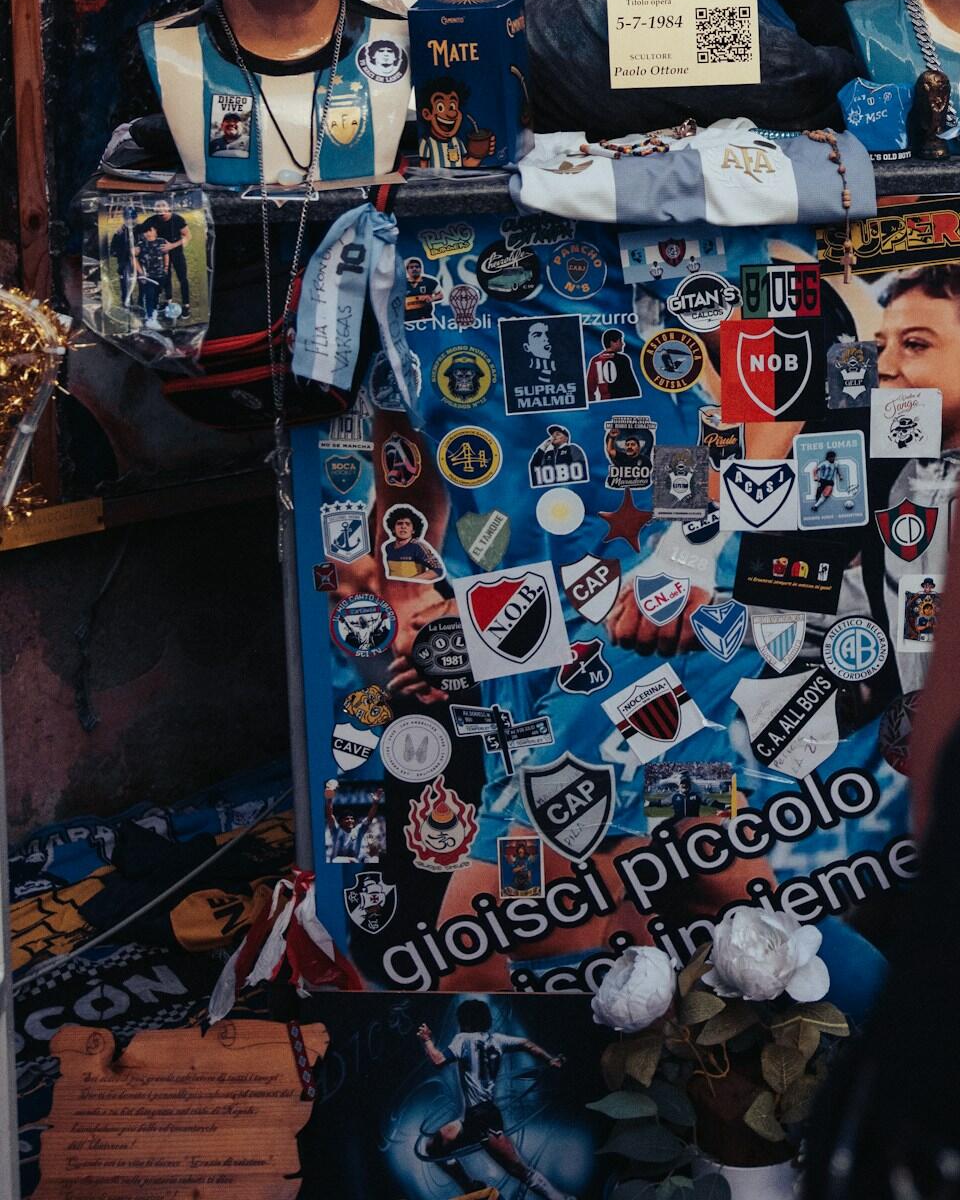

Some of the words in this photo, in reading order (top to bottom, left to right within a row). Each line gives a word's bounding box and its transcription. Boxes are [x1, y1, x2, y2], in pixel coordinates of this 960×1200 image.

[615, 15, 683, 31] 5-7-1984
[427, 40, 479, 68] MATE
[614, 66, 647, 77] Paolo
[650, 65, 689, 75] Ottone
[218, 95, 247, 104] DIEGO
[865, 110, 888, 124] MSC
[870, 153, 882, 161] L'S
[883, 153, 897, 161] OLD
[897, 151, 912, 160] BOYS
[336, 243, 367, 276] 10
[553, 244, 602, 269] PANCHO
[582, 312, 639, 327] zzurro
[692, 309, 724, 320] CALCOS
[331, 305, 352, 373] VARGAS
[646, 331, 675, 355] ASTON
[681, 331, 702, 360] VILLA
[750, 354, 799, 372] NOB
[595, 360, 618, 385] 10
[514, 383, 577, 397] SUPRAS
[653, 375, 688, 390] FUTSAL
[517, 394, 575, 409] MALMÖ
[800, 443, 823, 451] TRES
[826, 439, 857, 449] LOMAS
[611, 466, 650, 478] DIEGO
[572, 565, 609, 601] CAP
[348, 593, 375, 601] CANTO
[829, 619, 863, 640] ATLETICO
[866, 622, 888, 663] BELGRANO
[441, 655, 463, 667] 1981
[825, 643, 834, 665] CLUB
[837, 666, 878, 680] CORDOBA
[441, 677, 469, 691] SIDE
[780, 707, 806, 735] ALL
[796, 675, 832, 711] BOYS
[333, 738, 371, 758] CAVE
[547, 780, 595, 824] CAP
[382, 860, 610, 993] gioisci
[621, 772, 873, 910] piccolo
